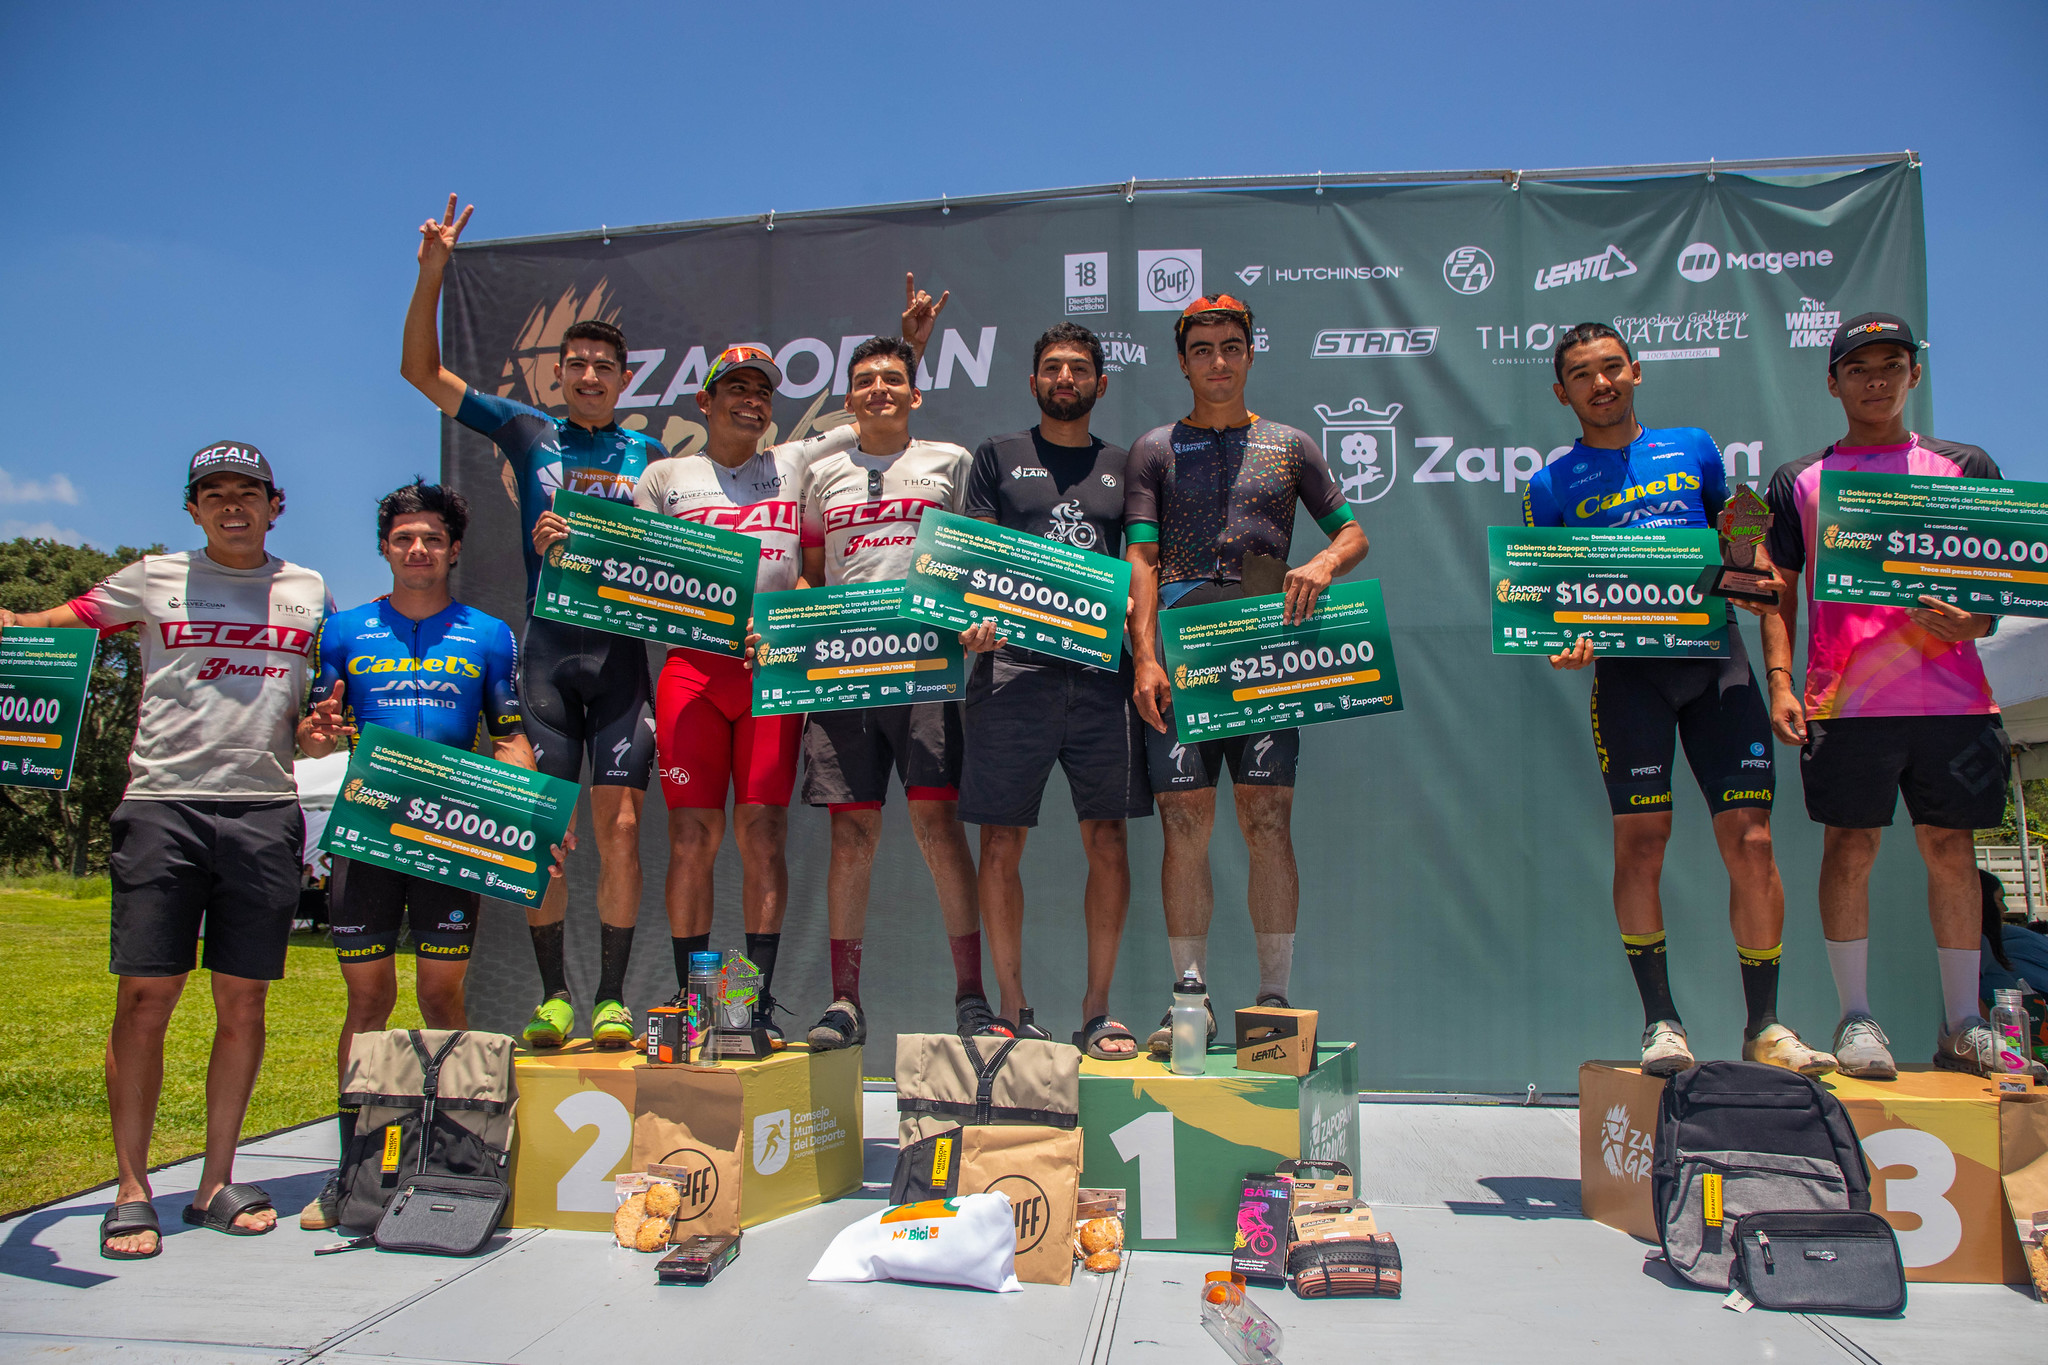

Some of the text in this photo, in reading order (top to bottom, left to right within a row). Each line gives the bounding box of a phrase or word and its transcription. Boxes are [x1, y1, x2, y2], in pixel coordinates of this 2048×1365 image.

[1726, 250, 1833, 274] Magene
[1276, 266, 1399, 281] HUTCHINSON
[1688, 309, 1749, 323] Galletas
[1785, 311, 1842, 330] WHEEL
[193, 446, 260, 469] ISCALI
[570, 470, 639, 484] TRANSPORTES
[1022, 470, 1048, 478] LAIN
[1576, 472, 1700, 518] Canel's
[824, 501, 925, 531] ISCAL
[1609, 500, 1689, 528] JAVA
[1731, 526, 1762, 536] GRAVEL
[1837, 530, 1882, 541] ZAPOPAN
[1834, 537, 1872, 551] GRAVEL
[1886, 529, 2048, 563] $13,000.00
[558, 557, 593, 575] GRAVEL
[561, 551, 602, 567] ZAPOPAN
[928, 559, 969, 576] ZAPOPAN
[601, 556, 737, 606] $20,000.00
[924, 564, 959, 582] GRAVEL
[969, 567, 1107, 621] $10,000.00
[1507, 592, 1542, 603] GRAVEL
[1509, 585, 1550, 593] ZAPOPAN
[168, 624, 314, 653] ISCALI
[815, 630, 938, 662] $8,000.00
[767, 652, 798, 665] GRAVEL
[768, 645, 806, 655] ZAPOPAN
[348, 655, 482, 679] Canel's
[1228, 639, 1375, 682] $25,000.00
[1185, 672, 1220, 688] GRAVEL
[1186, 664, 1227, 678] ZAPOPAN
[370, 680, 462, 694] JAVA
[377, 698, 456, 709] SHIMANO
[352, 791, 390, 811] GRAVEL
[358, 785, 401, 804] ZAPOPAN
[1723, 789, 1772, 802] Canel's
[405, 795, 538, 851] $5,000.00
[336, 944, 386, 957] Canel's
[420, 942, 470, 954] Canel's
[726, 987, 754, 1000] GRAVEL
[794, 1106, 829, 1124] Consejo
[794, 1116, 837, 1138] Municipal
[794, 1129, 846, 1151] del Deporte
[554, 1091, 632, 1213] 2
[1109, 1112, 1177, 1239] 1
[1861, 1128, 1962, 1268] 3
[908, 1226, 928, 1241] Bici
